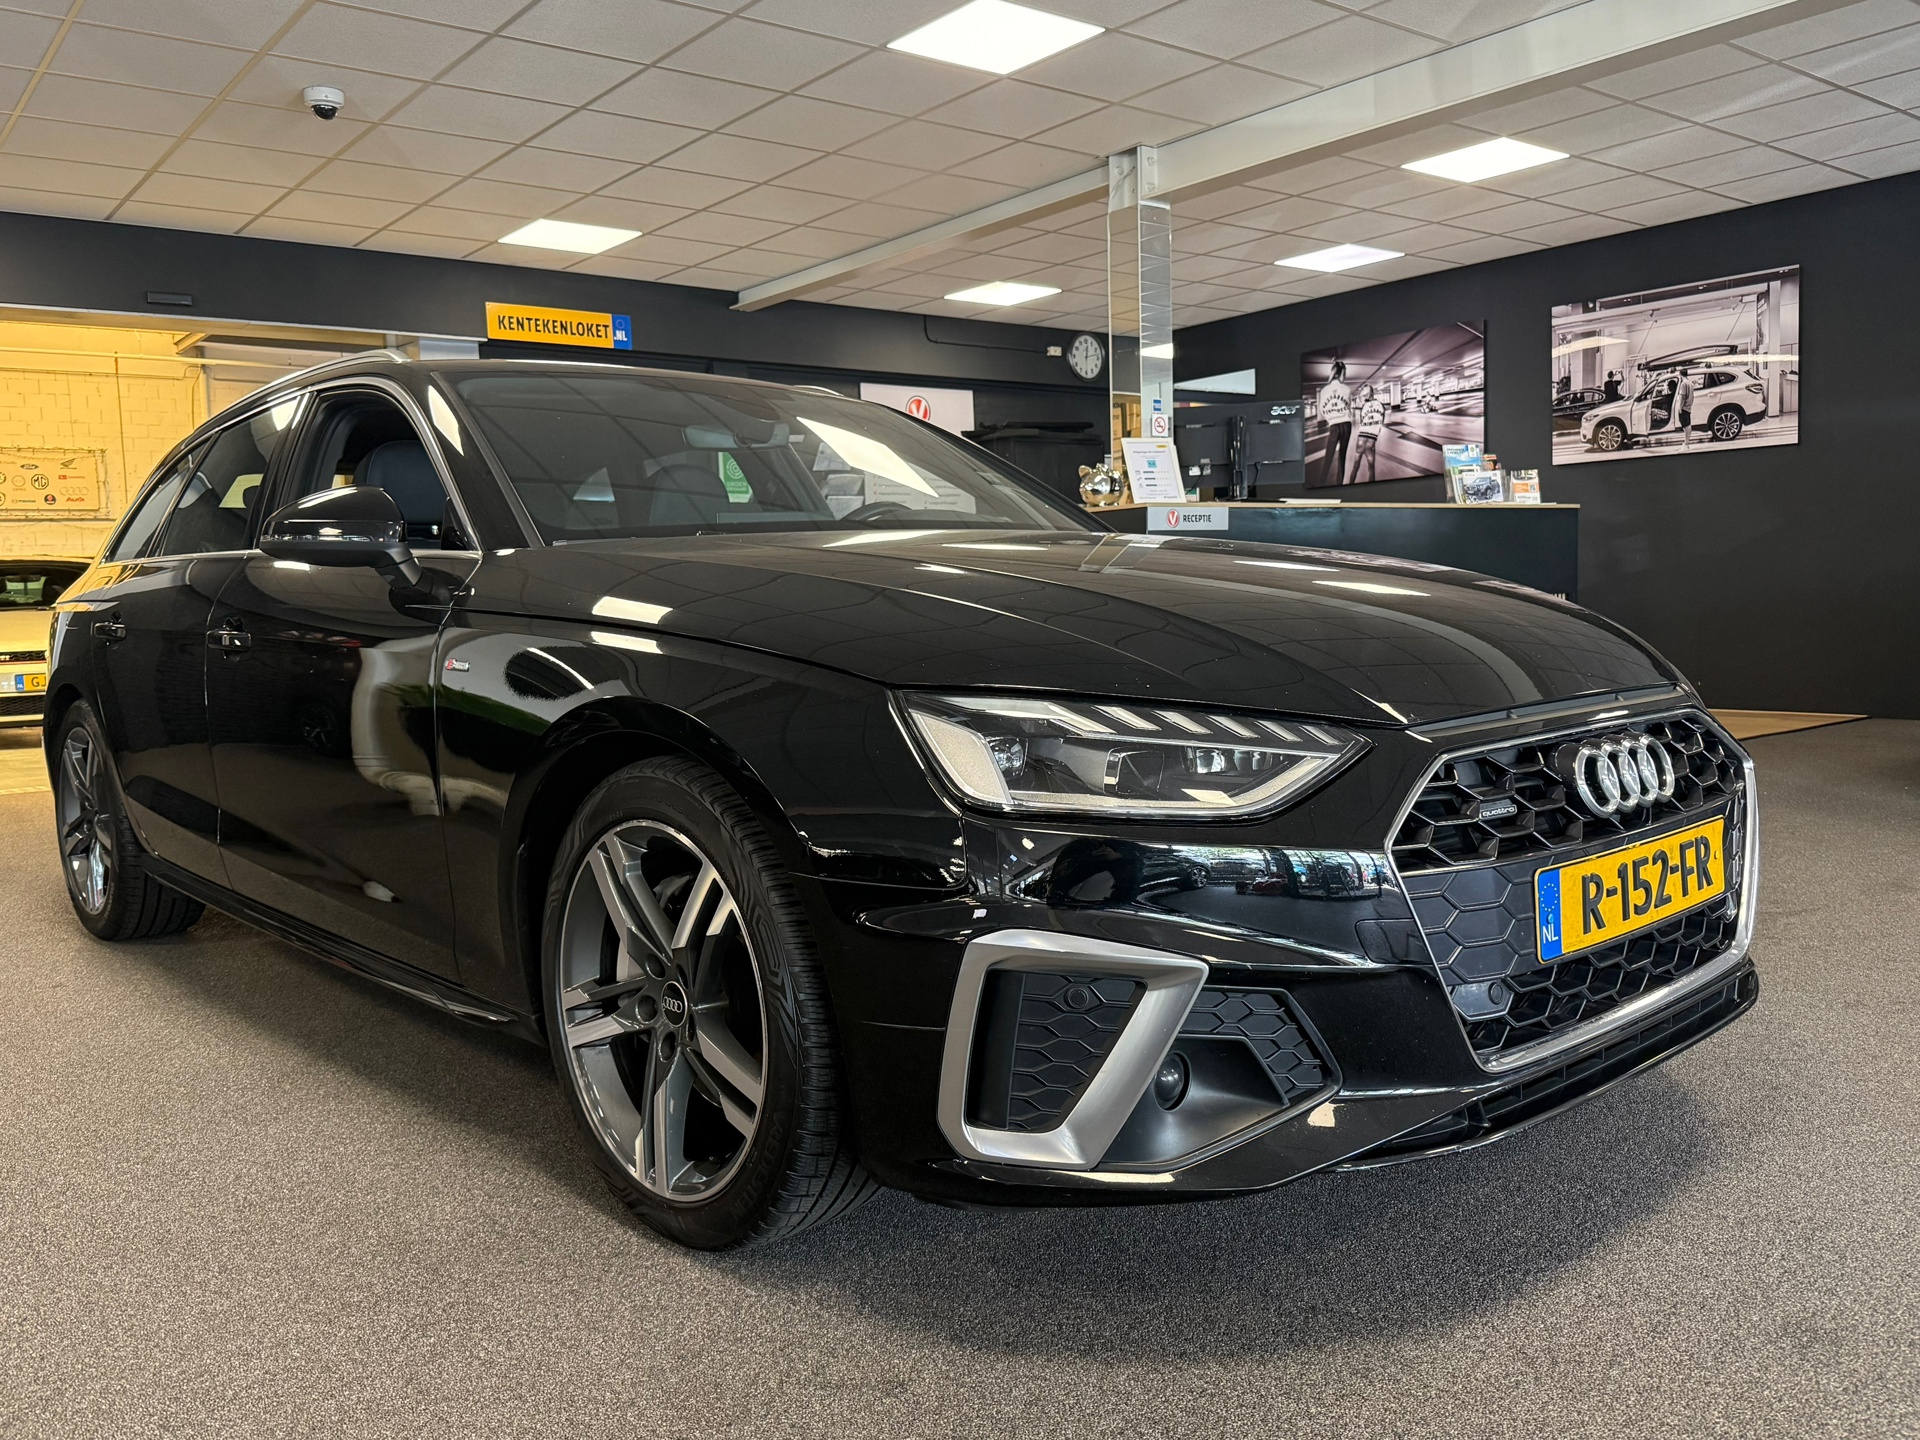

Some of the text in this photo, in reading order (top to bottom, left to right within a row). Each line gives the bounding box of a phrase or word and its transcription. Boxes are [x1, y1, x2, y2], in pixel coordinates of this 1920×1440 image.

[497, 314, 610, 339] KENTEKENLOKET
[1270, 405, 1300, 416] acer
[33, 476, 47, 488] MG
[1183, 514, 1212, 523] RECEPTIE
[1482, 807, 1515, 818] quattro
[1581, 835, 1714, 936] R-152-FR
[1542, 924, 1559, 944] NL
